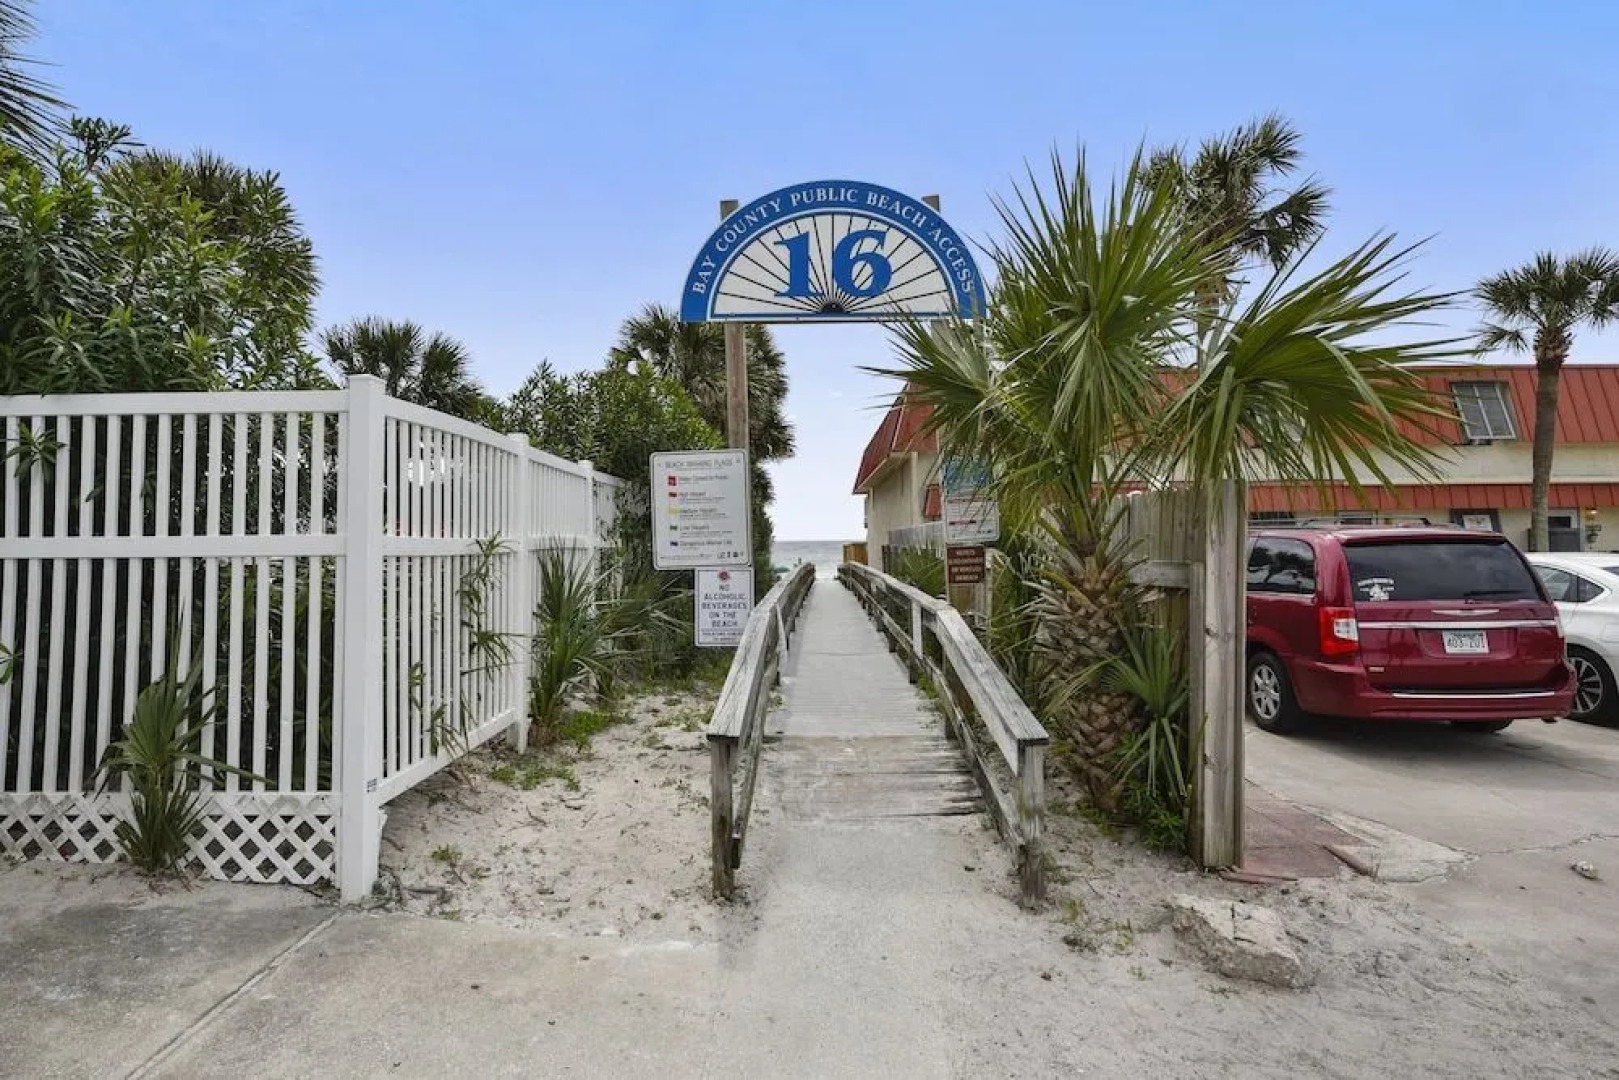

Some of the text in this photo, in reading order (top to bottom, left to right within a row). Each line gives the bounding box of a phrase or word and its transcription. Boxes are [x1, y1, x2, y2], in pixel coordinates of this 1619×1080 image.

[693, 187, 973, 294] BAY COUNTY PUBLIC BEACH ACCESS
[773, 229, 893, 298] 16
